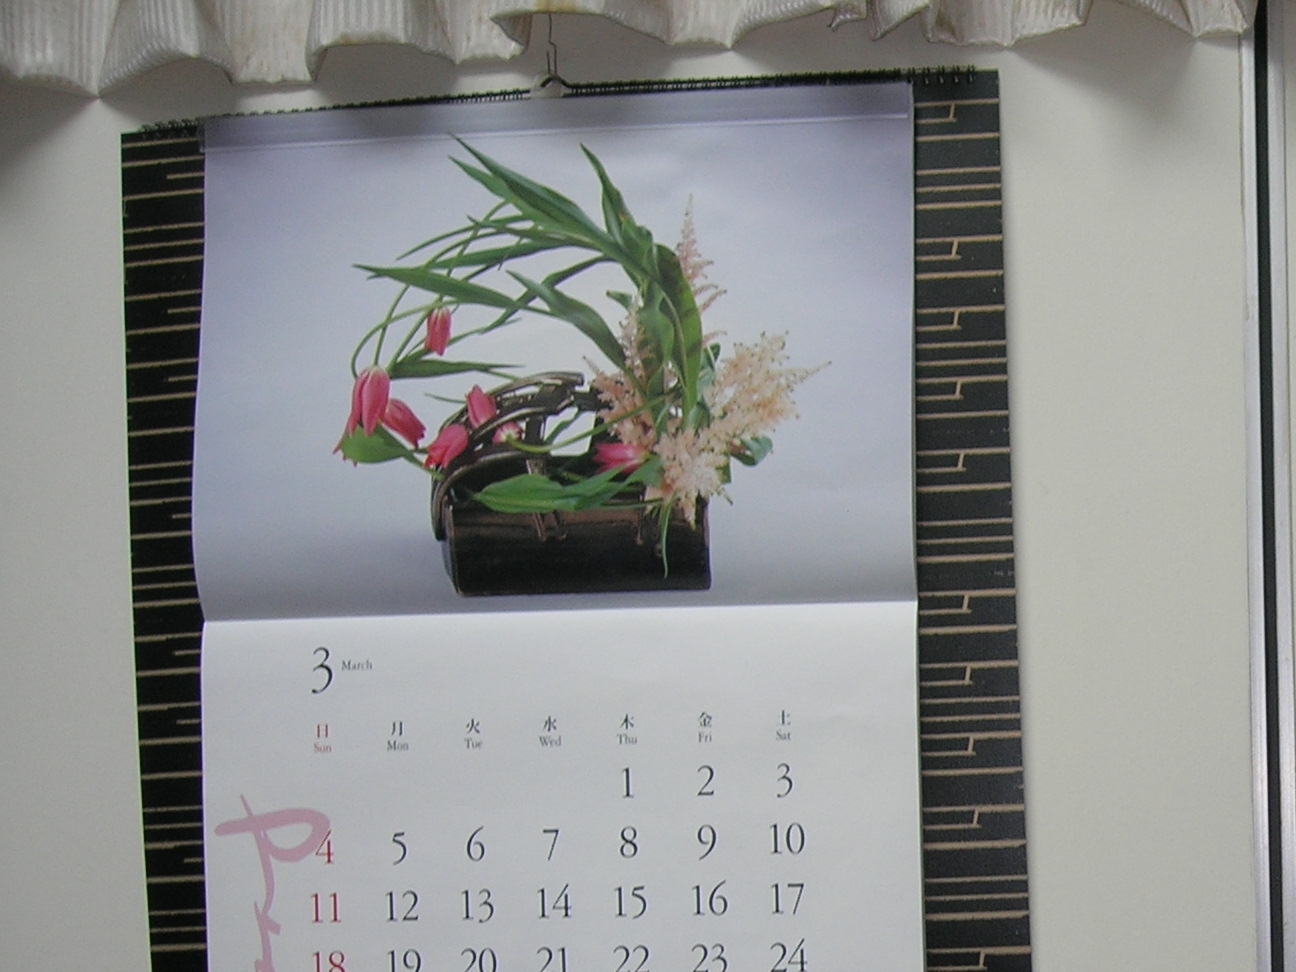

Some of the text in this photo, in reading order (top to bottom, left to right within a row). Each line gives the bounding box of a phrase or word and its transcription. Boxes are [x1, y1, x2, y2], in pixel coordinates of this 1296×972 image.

[311, 647, 373, 694] 3 March
[313, 730, 791, 754] Sun Mon Tue Wed Thu Fri Sat
[316, 709, 791, 739] 日 月 火 水 木 金 土
[621, 763, 793, 799] 1 2 3
[314, 823, 805, 866] 4 5 6 7 8 9 10
[311, 880, 805, 924] 11 12 13 14 15 16 17
